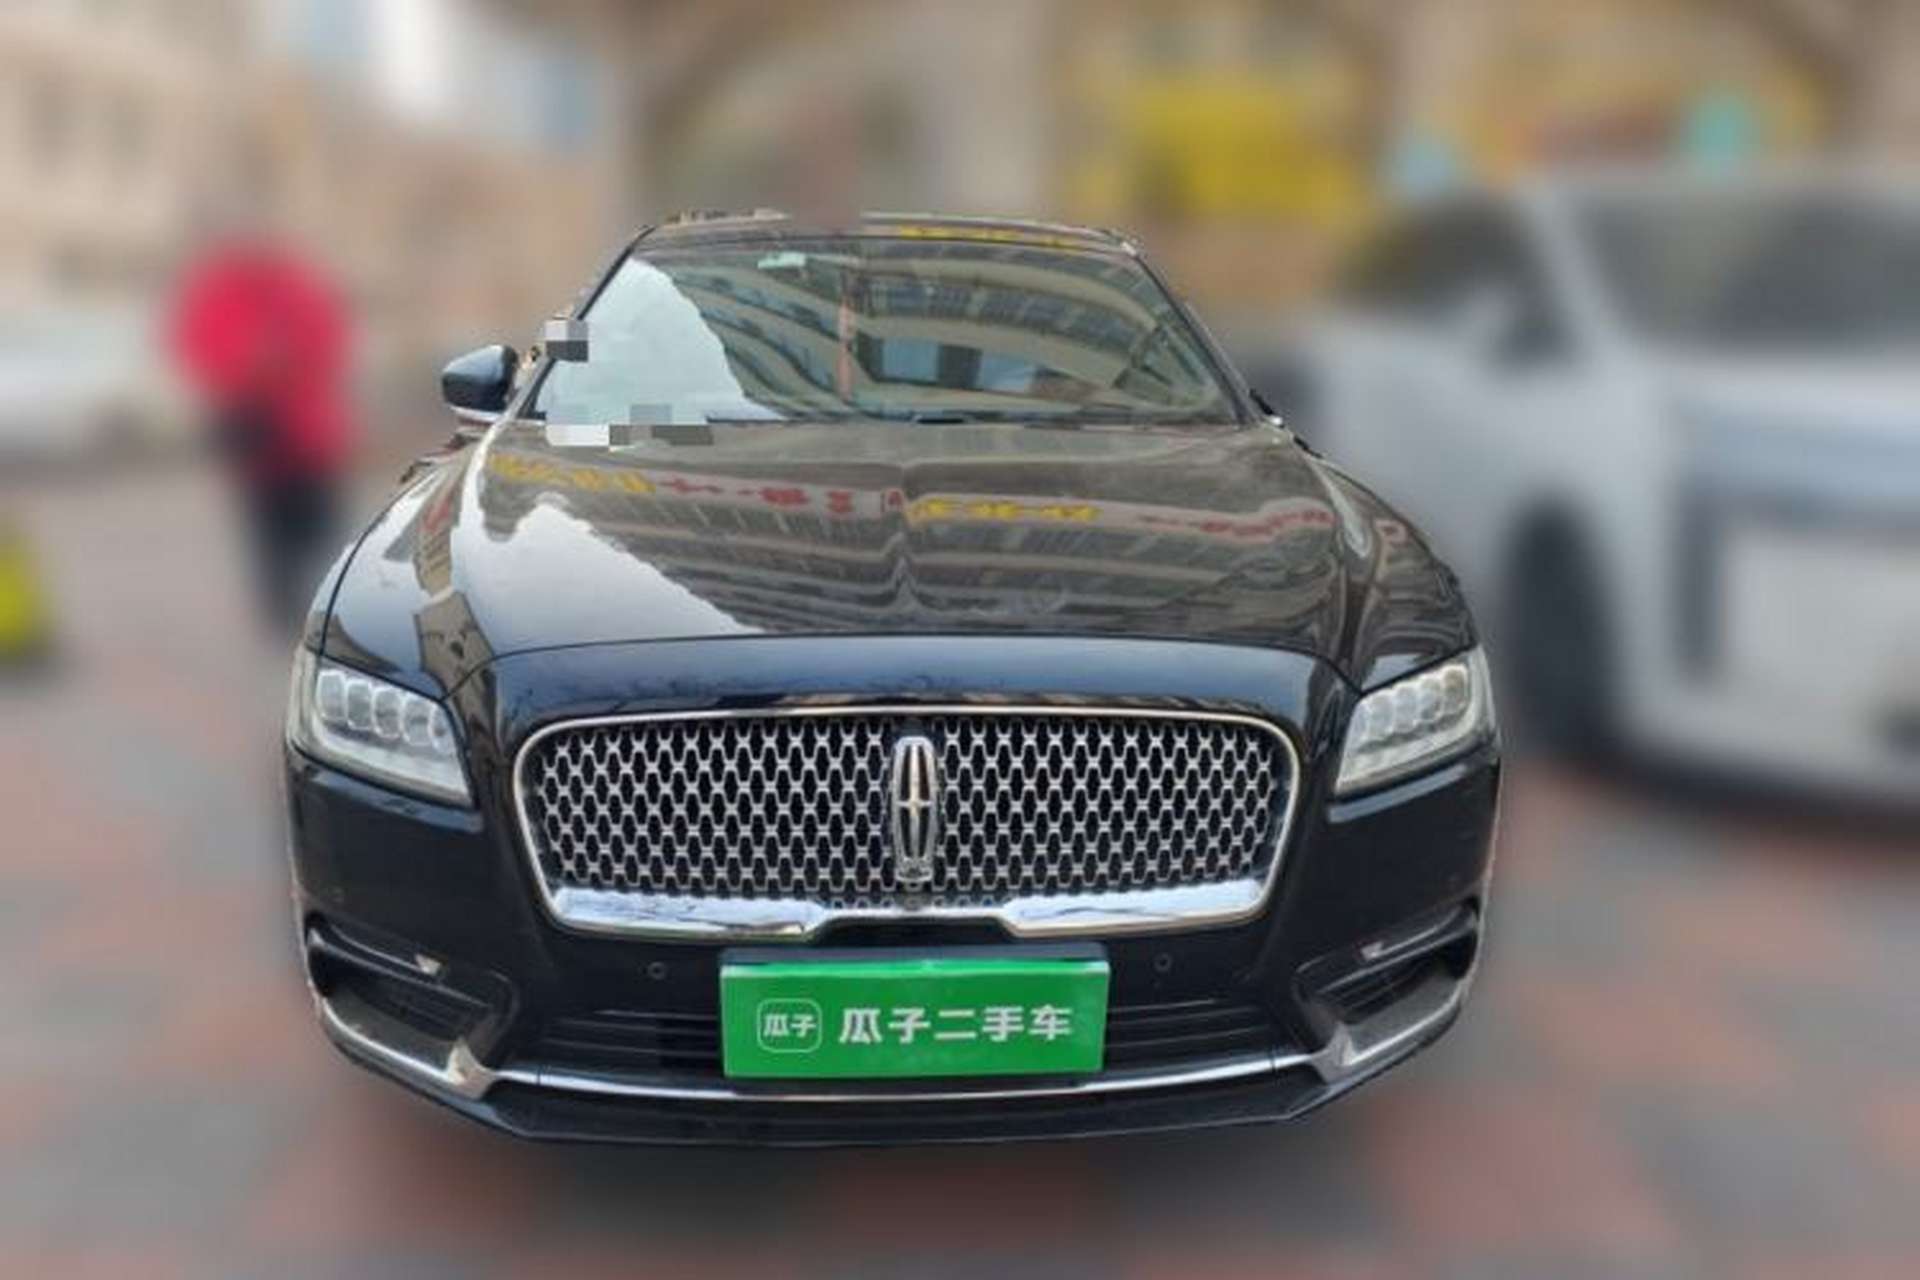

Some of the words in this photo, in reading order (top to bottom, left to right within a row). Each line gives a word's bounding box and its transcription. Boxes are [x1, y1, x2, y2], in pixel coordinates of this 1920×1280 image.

[762, 1013, 817, 1038] 瓜子
[838, 1004, 1074, 1044] 瓜子二手车
